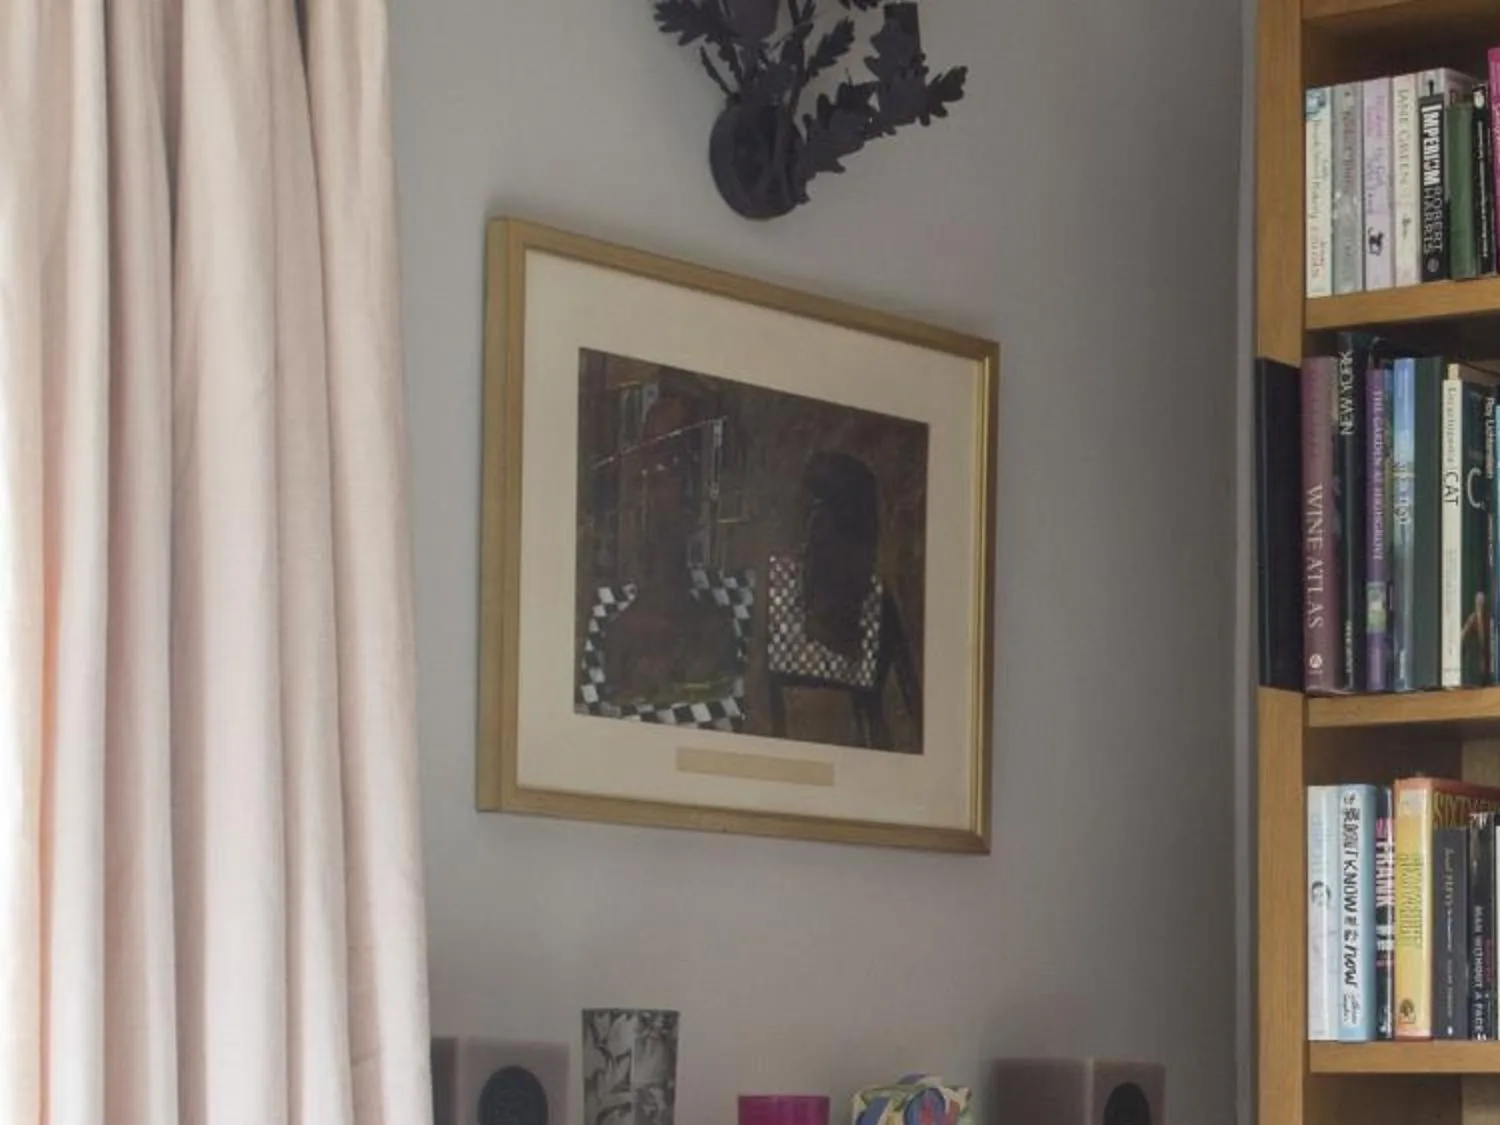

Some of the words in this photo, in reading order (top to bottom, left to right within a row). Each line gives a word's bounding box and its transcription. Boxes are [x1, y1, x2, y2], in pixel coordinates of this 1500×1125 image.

[1421, 104, 1443, 187] IMPERIUM
[1443, 471, 1459, 506] CAT
[1306, 482, 1323, 551] WINE
[1306, 555, 1324, 629] ATLAS
[1343, 860, 1358, 913] KNOW
[1376, 841, 1395, 908] FRANK
[1344, 944, 1359, 988] now
[1473, 936, 1484, 988] WITHOUT
[1473, 1003, 1484, 1034] FACE
